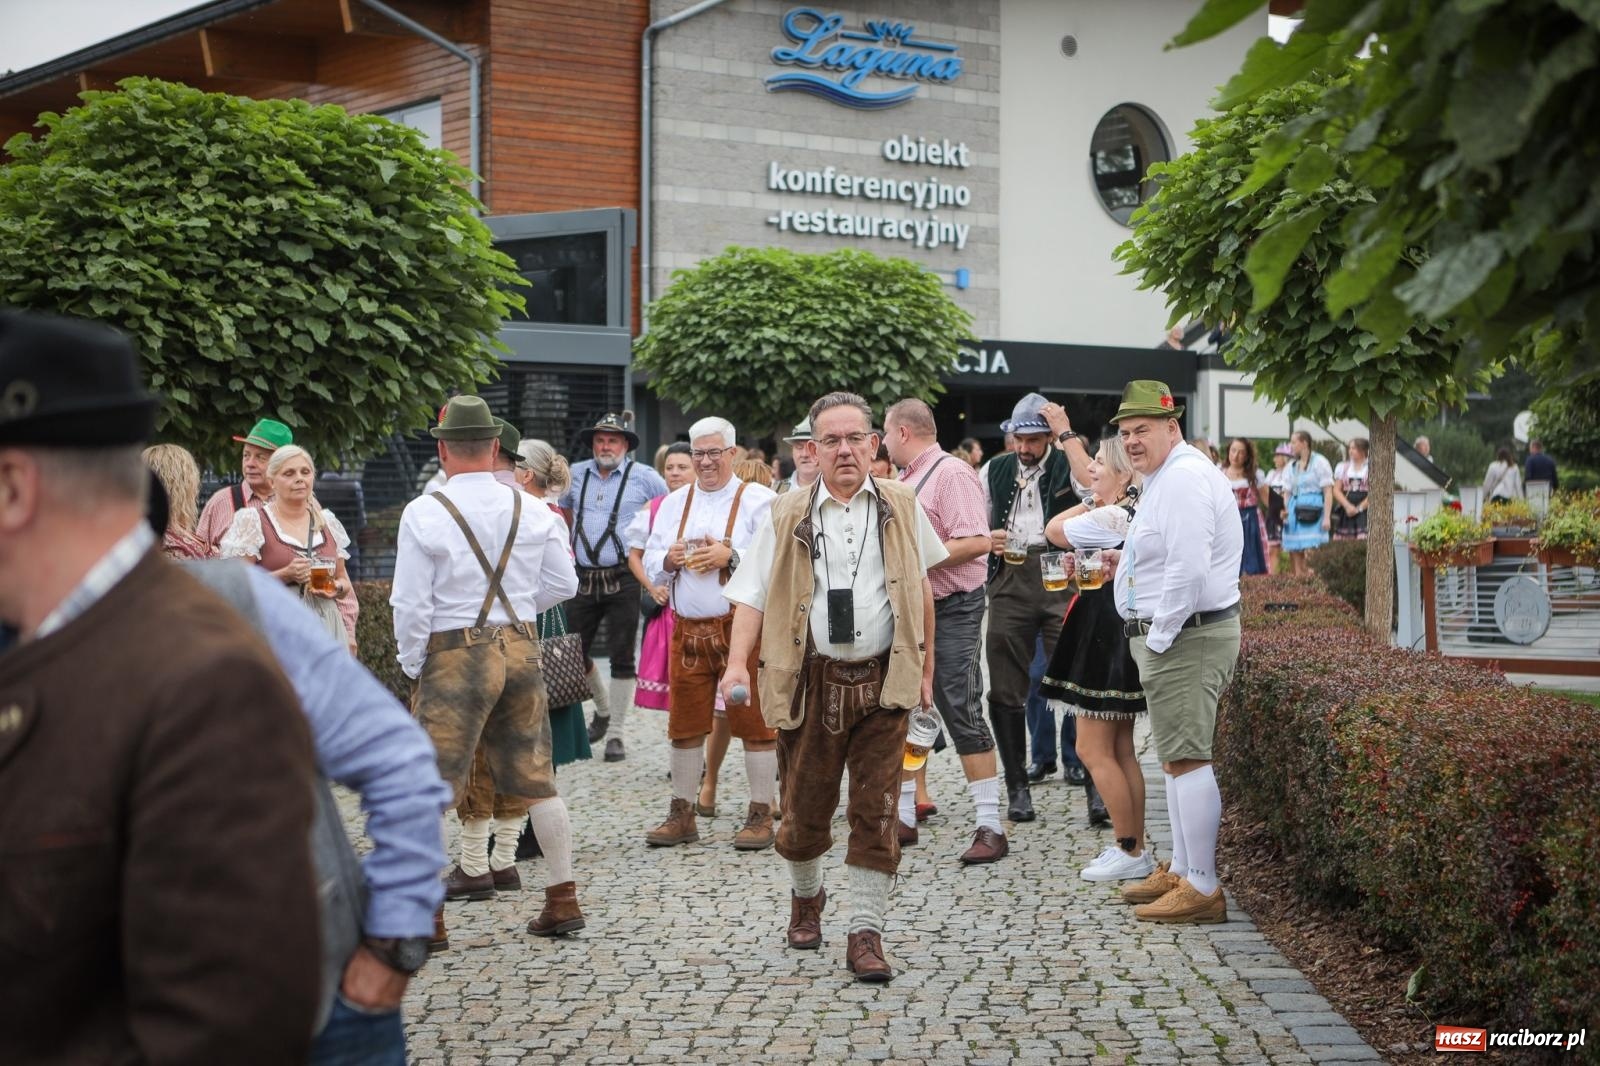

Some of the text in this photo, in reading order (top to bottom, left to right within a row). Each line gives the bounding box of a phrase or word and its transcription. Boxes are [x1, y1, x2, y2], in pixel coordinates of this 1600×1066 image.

[771, 7, 962, 87] Laguna
[884, 135, 970, 166] obiekt
[770, 162, 970, 208] konferencyjno
[768, 208, 969, 249] -restauracyjny
